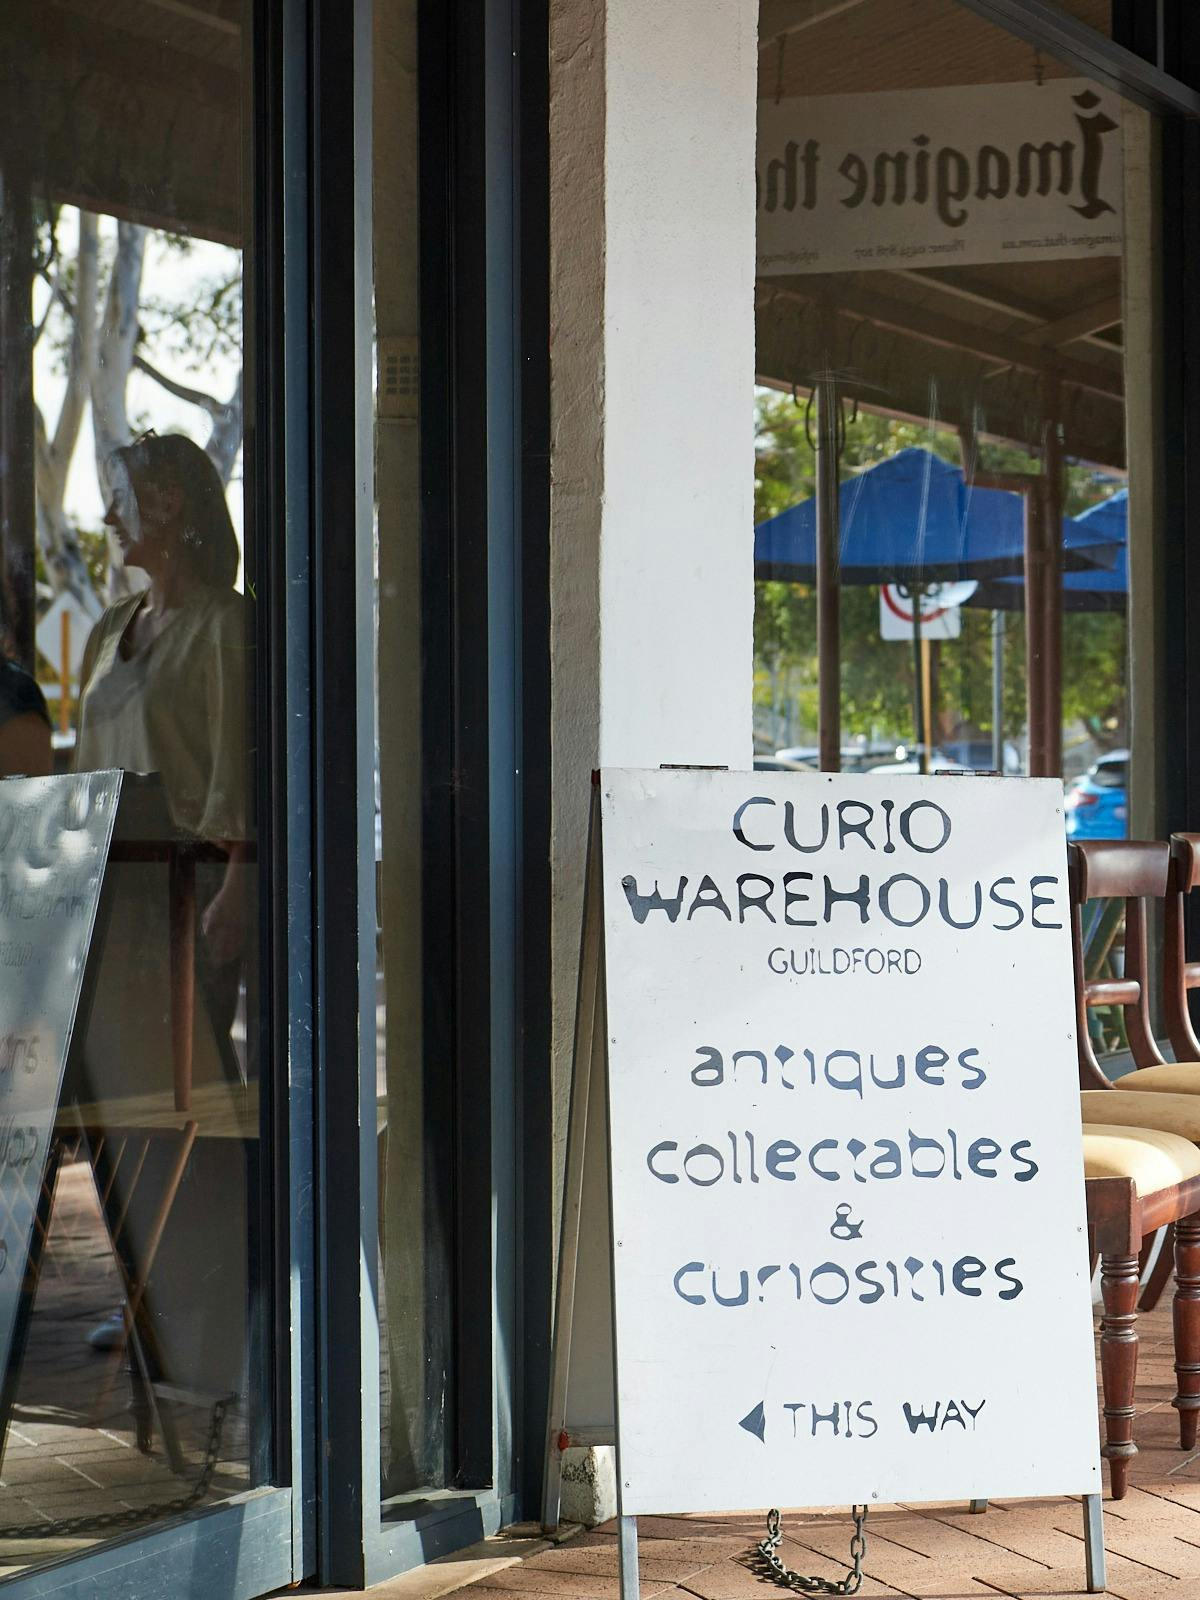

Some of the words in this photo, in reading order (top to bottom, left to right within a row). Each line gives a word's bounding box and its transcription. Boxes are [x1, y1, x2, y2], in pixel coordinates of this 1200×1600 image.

[733, 796, 951, 853] CURIO
[621, 872, 1063, 930] WAREHOUSE
[768, 947, 922, 975] GUILDFORD
[691, 1044, 987, 1100] antiques
[647, 1129, 1039, 1187] collectables
[830, 1203, 865, 1240] &
[674, 1255, 1024, 1307] curiosities
[783, 1400, 878, 1438] THIS
[903, 1399, 986, 1435] WAY
